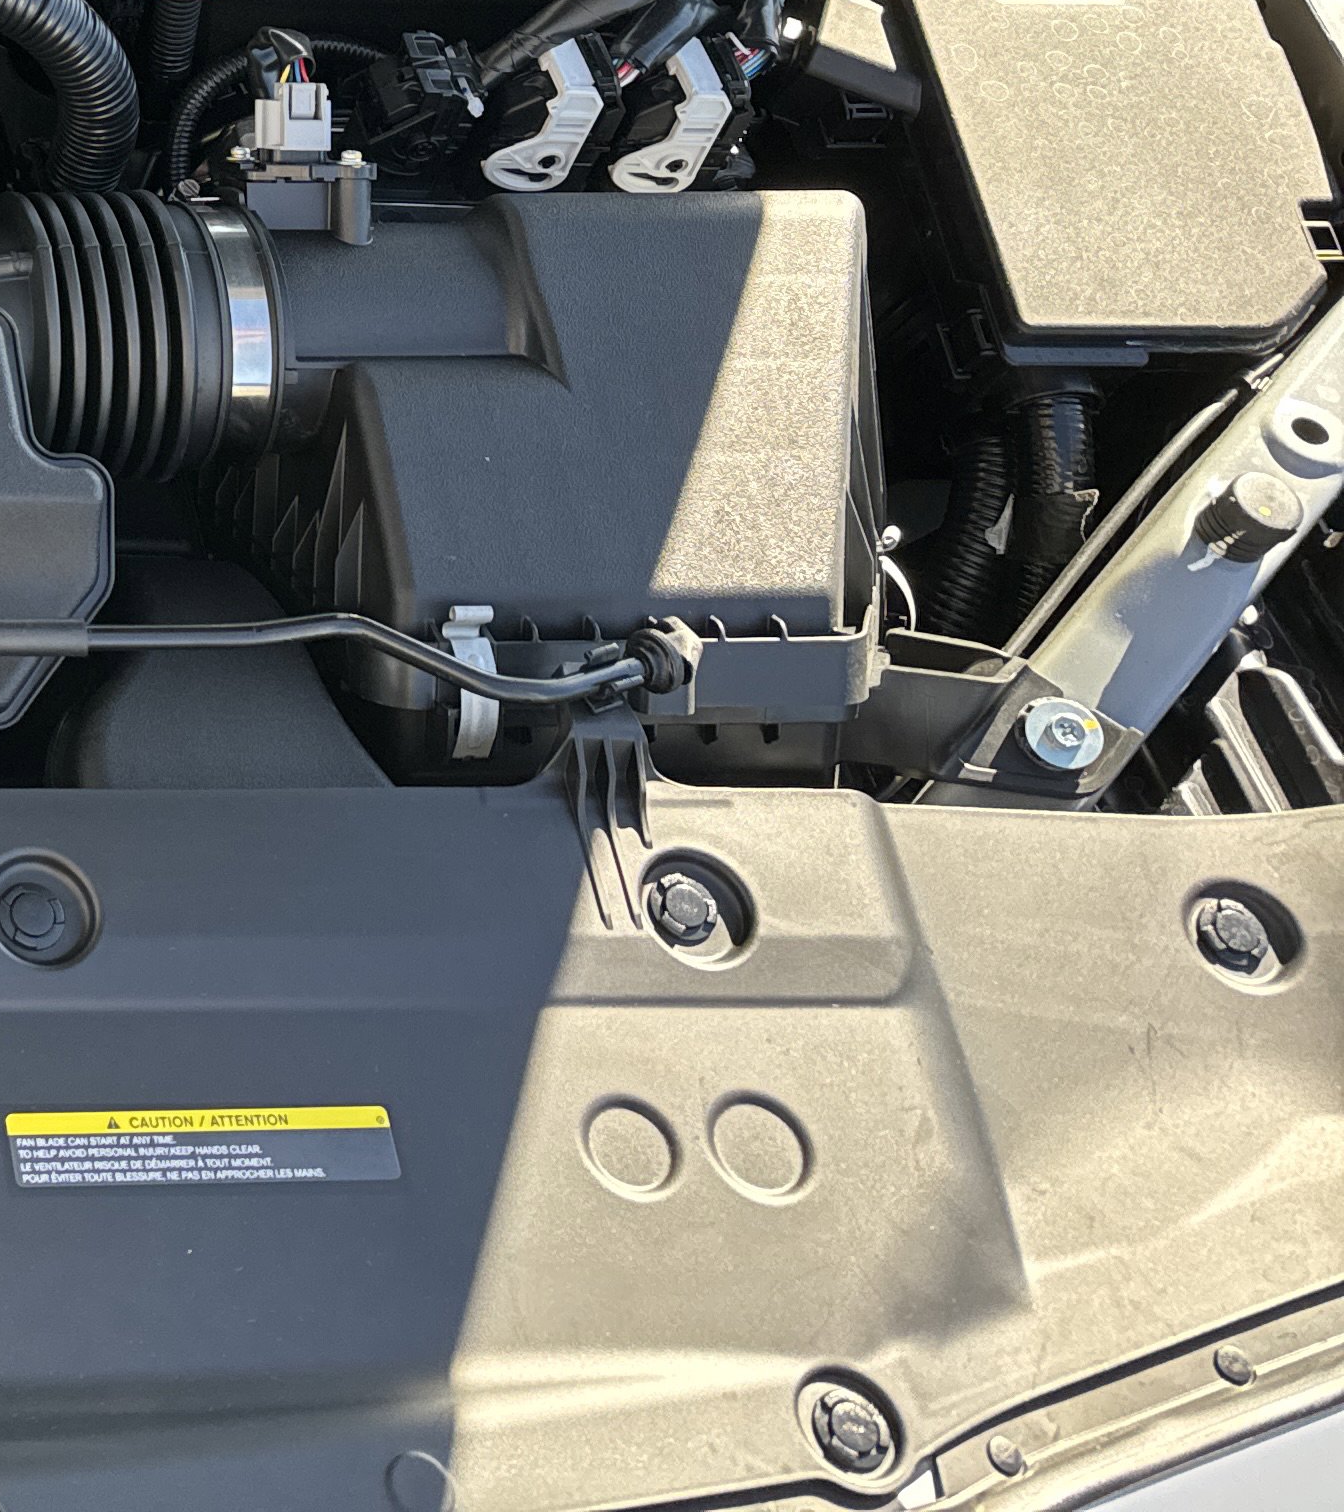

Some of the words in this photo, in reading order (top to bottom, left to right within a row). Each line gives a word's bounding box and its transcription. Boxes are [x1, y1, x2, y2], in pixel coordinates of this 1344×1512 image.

[128, 1115, 193, 1128] CAUTION
[198, 1115, 206, 1126] /
[209, 1113, 289, 1127] ATTENTION
[16, 1137, 35, 1146] FAN
[36, 1137, 66, 1146] BLADE
[67, 1136, 88, 1145] CAN
[89, 1136, 117, 1145] START
[119, 1136, 131, 1144] AT
[131, 1135, 151, 1144] ANY
[18, 1149, 31, 1158] TO
[33, 1149, 57, 1158] HELP
[58, 1148, 86, 1157] AVOID
[87, 1147, 136, 1157] PERSONAL
[169, 1146, 194, 1155] KEEP
[194, 1145, 228, 1154] HANDS
[20, 1162, 32, 1171] LE
[33, 1161, 92, 1171] VENTILATEUR
[93, 1160, 129, 1170] RISQUE
[130, 1160, 143, 1169] DE
[144, 1157, 195, 1169] DÉMARRER
[196, 1157, 203, 1168] À
[205, 1159, 229, 1167] TOUT
[22, 1174, 49, 1182] POUR
[50, 1171, 82, 1182] ÉVITER
[83, 1173, 113, 1181] TOUTE
[115, 1172, 165, 1182] BLESSURE,
[166, 1172, 179, 1180] NE
[181, 1171, 200, 1180] PAS
[201, 1171, 214, 1179] EN
[216, 1170, 273, 1179] APPROCHER
[275, 1169, 292, 1178] LES
